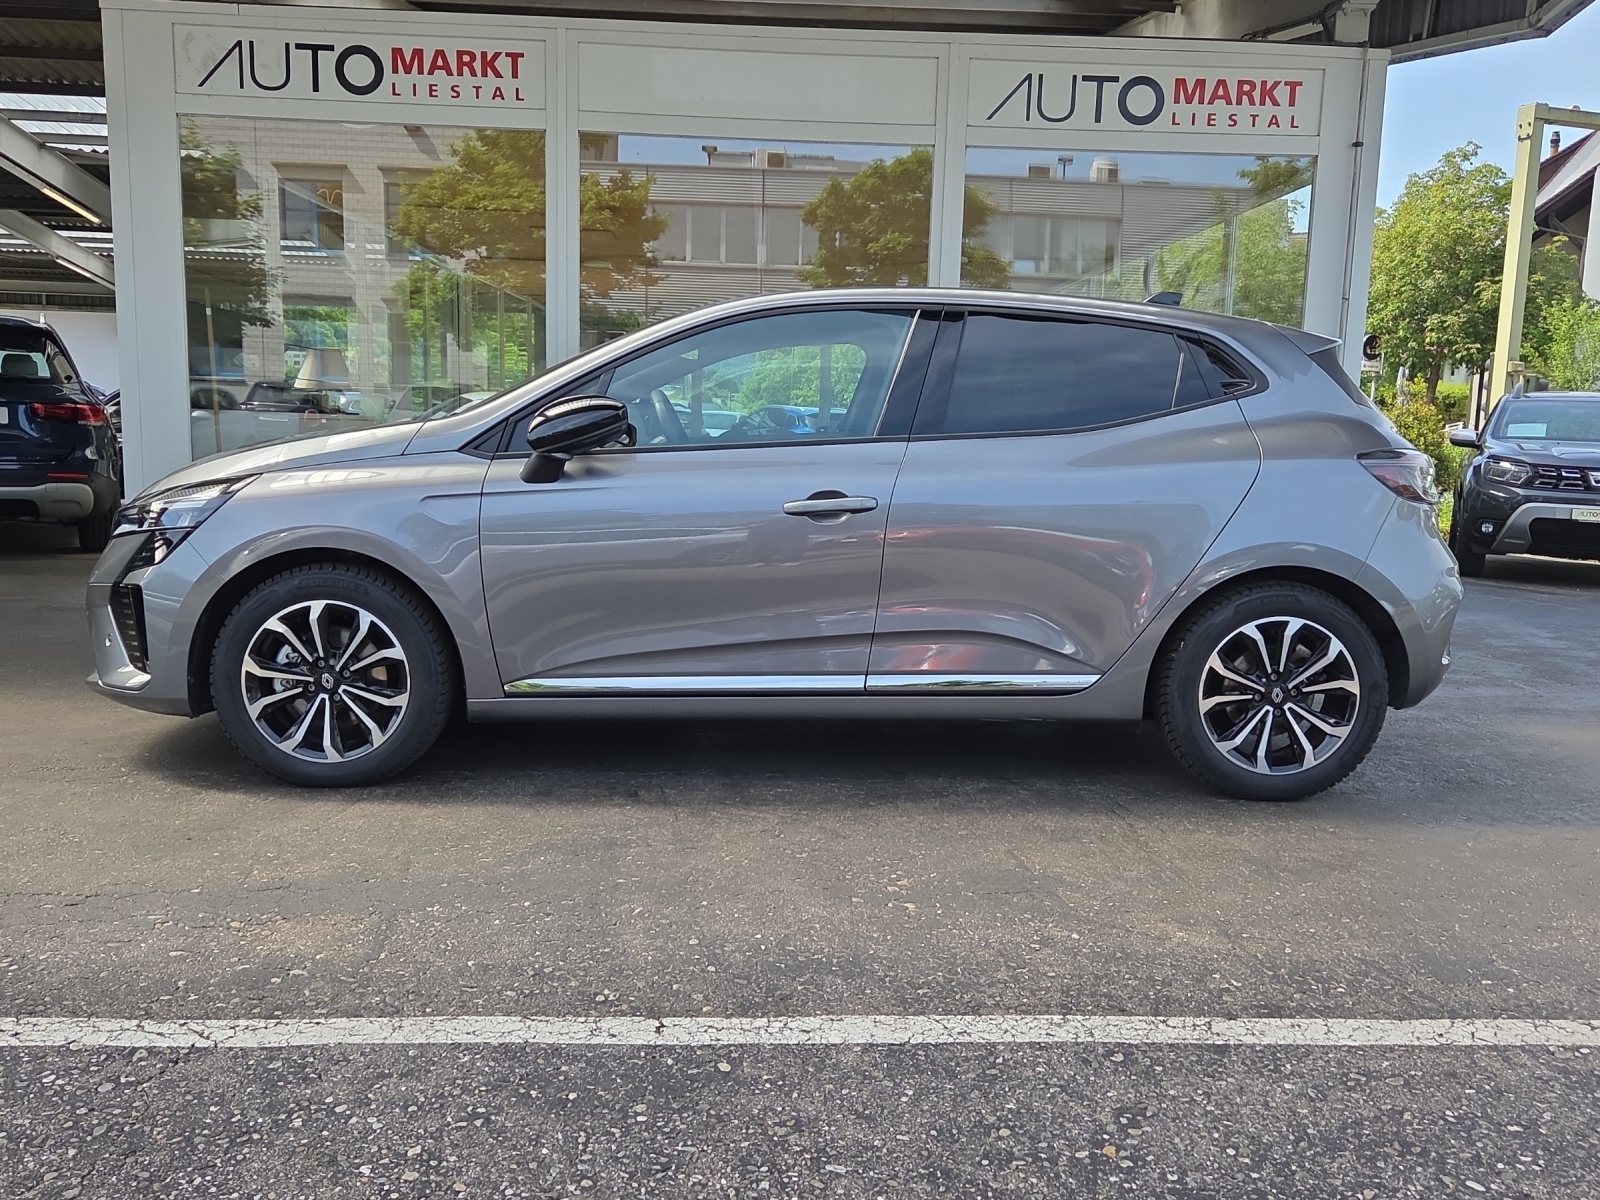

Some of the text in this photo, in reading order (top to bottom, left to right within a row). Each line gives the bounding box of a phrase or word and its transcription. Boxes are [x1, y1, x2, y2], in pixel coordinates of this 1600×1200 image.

[197, 39, 525, 96] AUTO MARKT
[391, 82, 525, 101] LIESTAL
[986, 72, 1303, 126] AUTO MARKT
[1171, 112, 1299, 128] LIESTAL
[1576, 511, 1599, 519] AUTO
